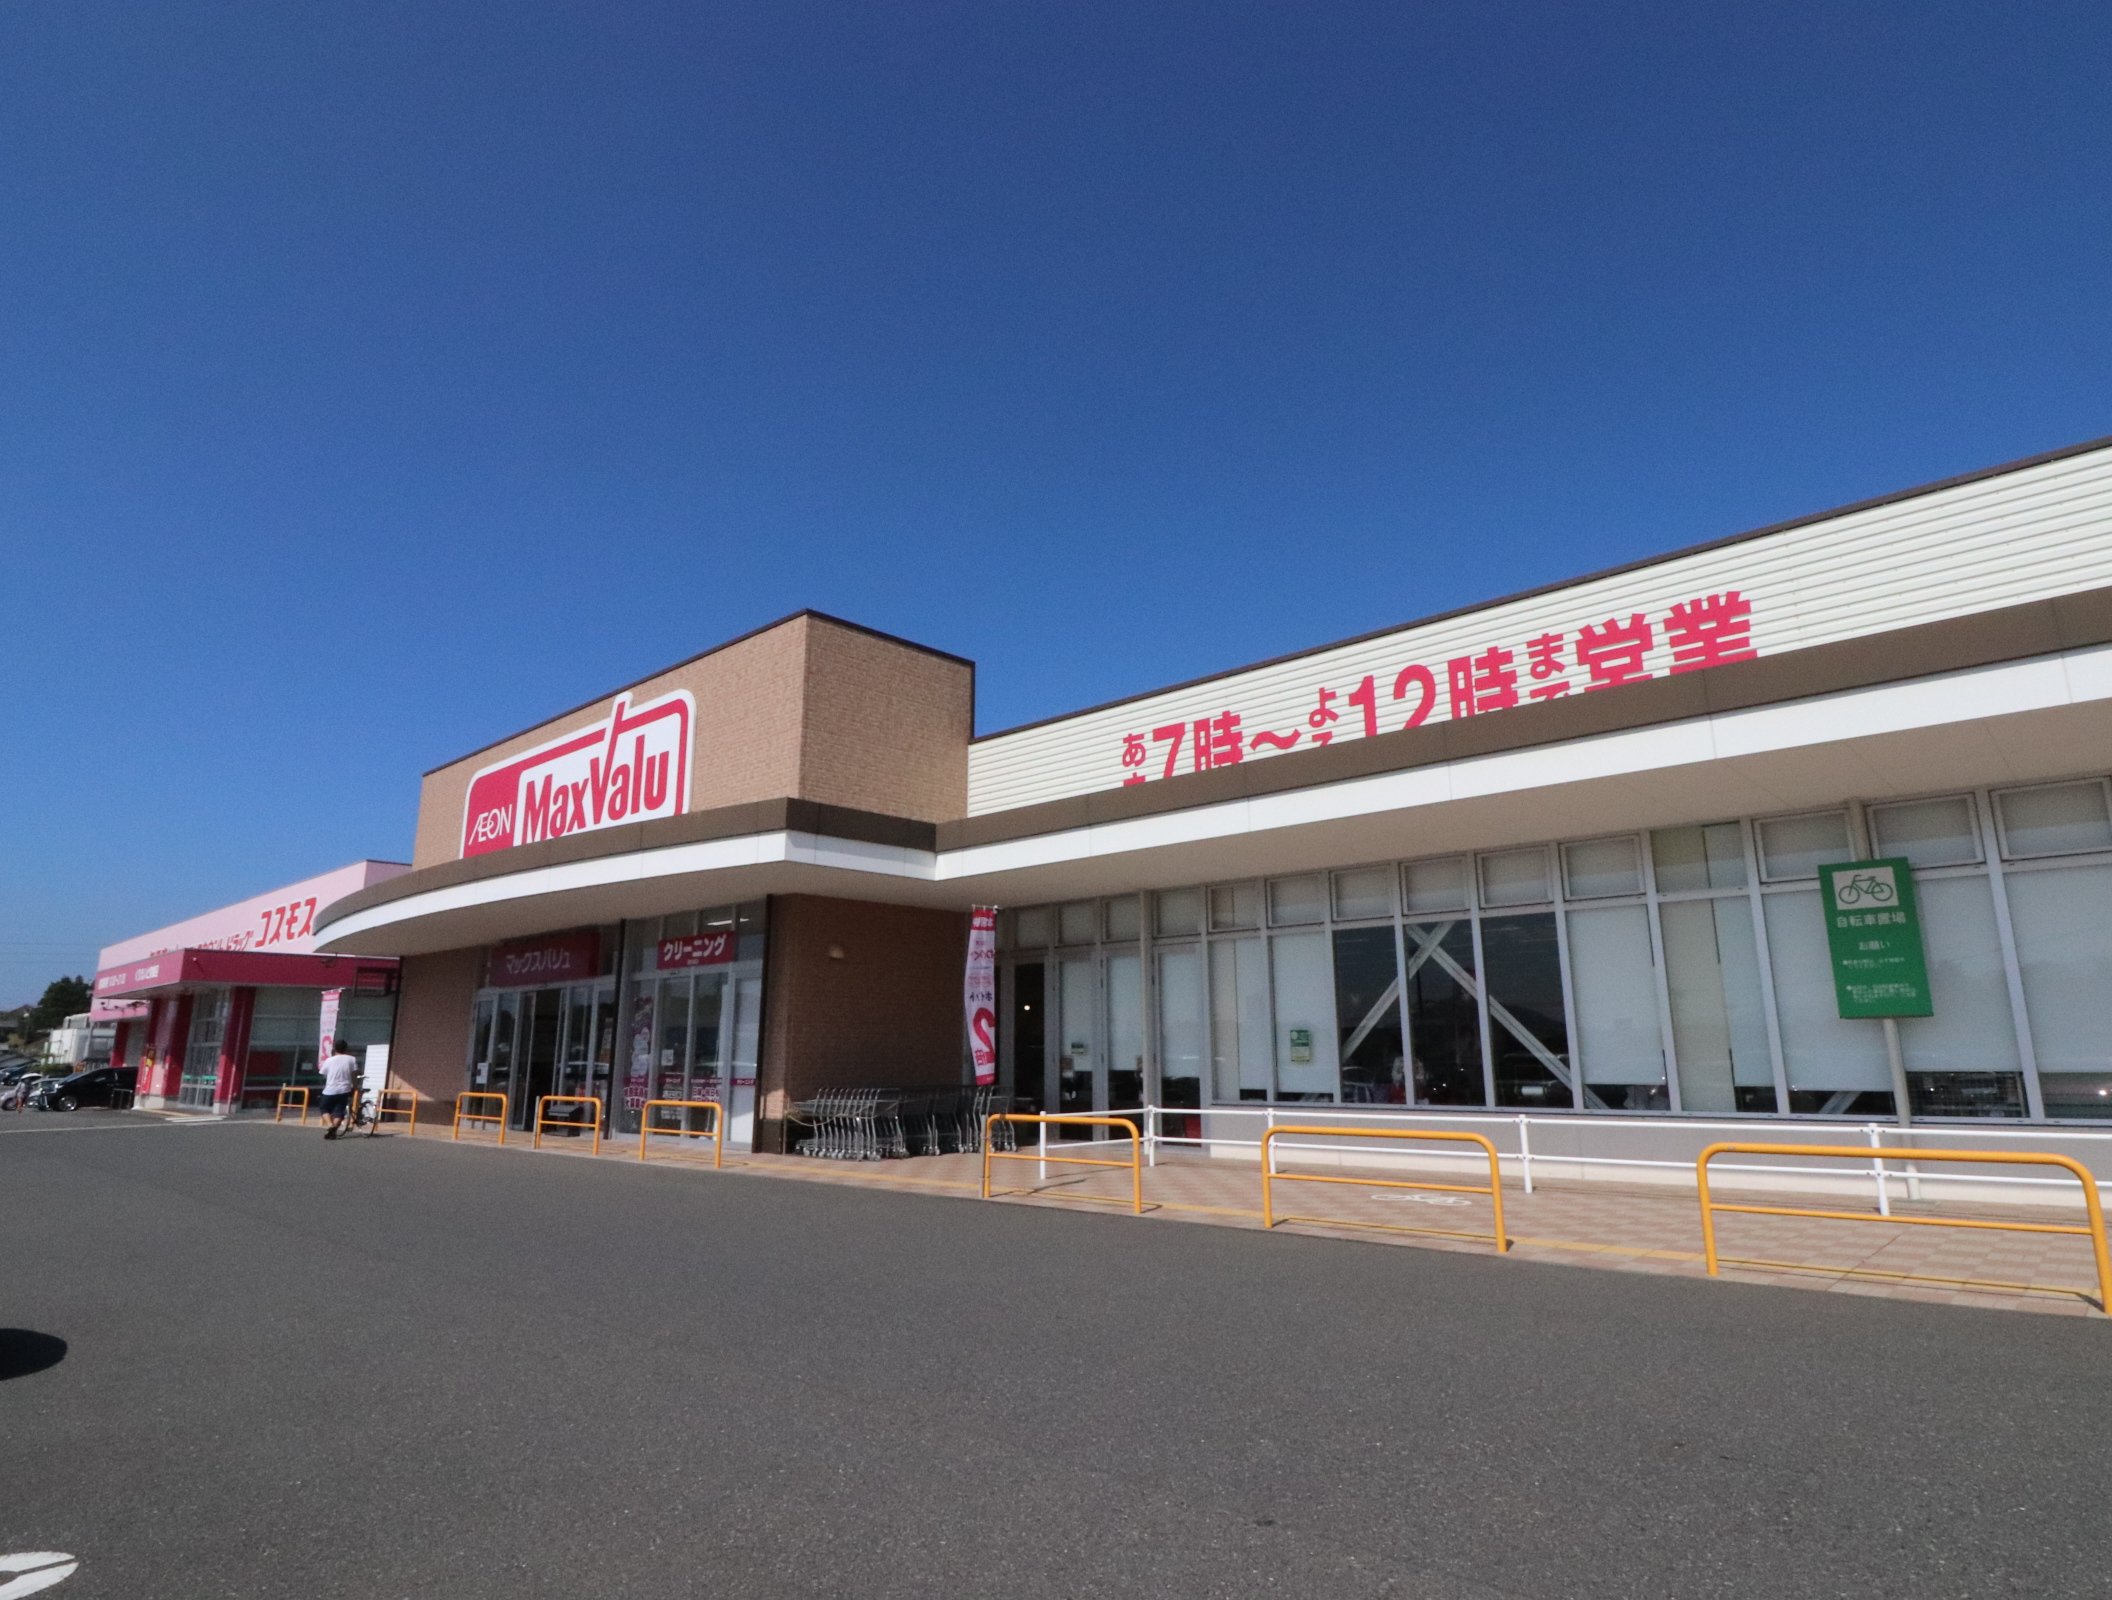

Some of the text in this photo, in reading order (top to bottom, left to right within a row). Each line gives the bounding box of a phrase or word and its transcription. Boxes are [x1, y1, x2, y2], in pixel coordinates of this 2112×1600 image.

[521, 701, 670, 845] MaxValu
[255, 896, 318, 948] コスモス
[1836, 911, 1906, 929] 自転車置場
[505, 947, 571, 975] マックスバリュ
[663, 934, 727, 962] クリーニング
